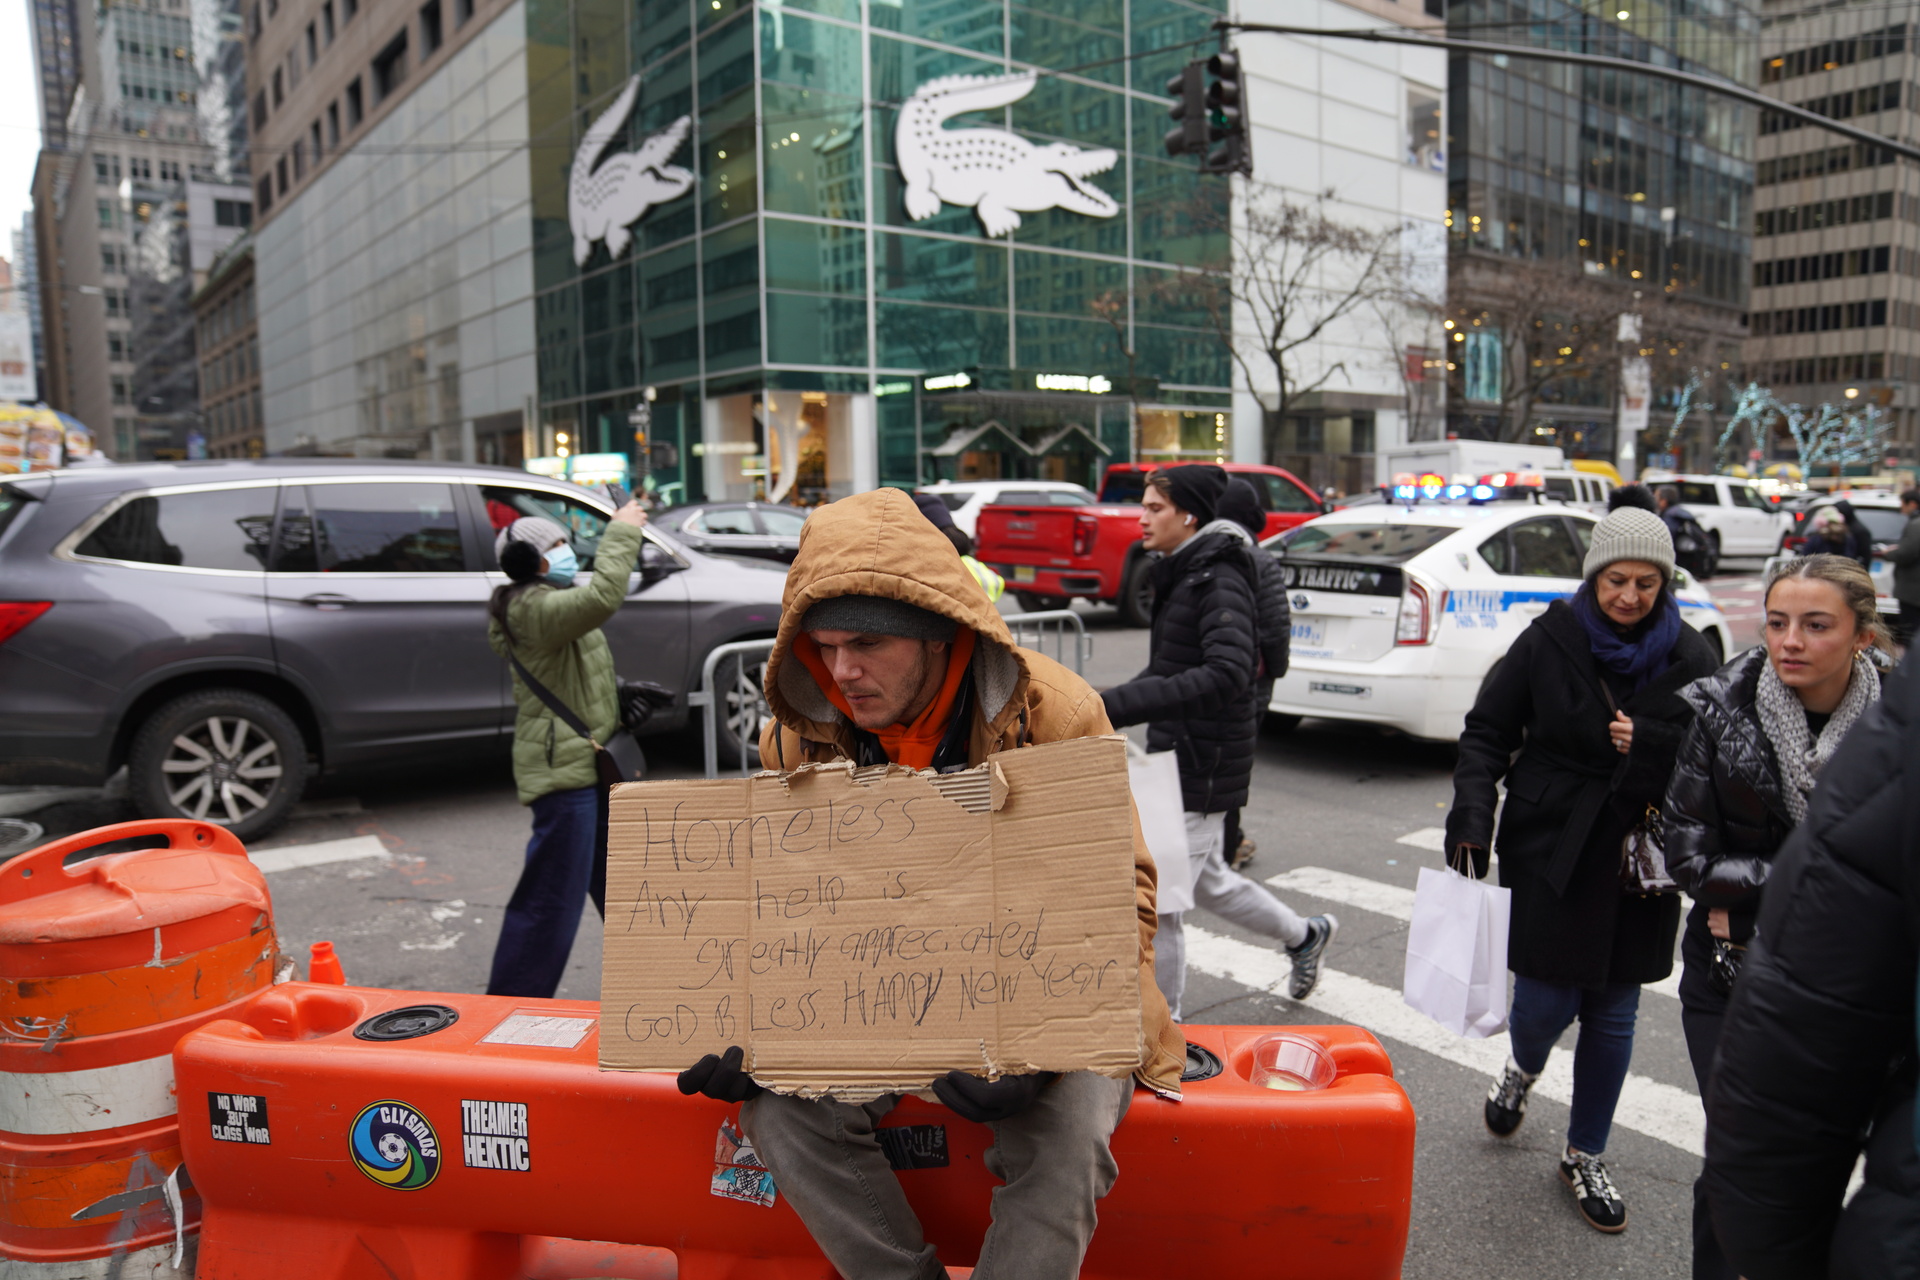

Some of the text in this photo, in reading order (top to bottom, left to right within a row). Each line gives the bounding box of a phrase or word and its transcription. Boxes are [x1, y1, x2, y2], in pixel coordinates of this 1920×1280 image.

[1298, 567, 1359, 590] TRAFFIC
[643, 797, 922, 872] Homeless
[627, 872, 907, 940] Any help is
[679, 907, 1044, 990] greatly appreciated
[844, 967, 943, 1026] HAPPY
[958, 966, 1021, 1022] New
[1031, 953, 1117, 998] Year
[217, 1095, 257, 1112] NO WAR
[227, 1110, 248, 1128] BUT
[462, 1100, 528, 1137] THEAMER
[212, 1124, 270, 1143] CLASS WAR
[380, 1106, 437, 1158] CLYSMOS
[463, 1134, 530, 1171] HEKTIC
